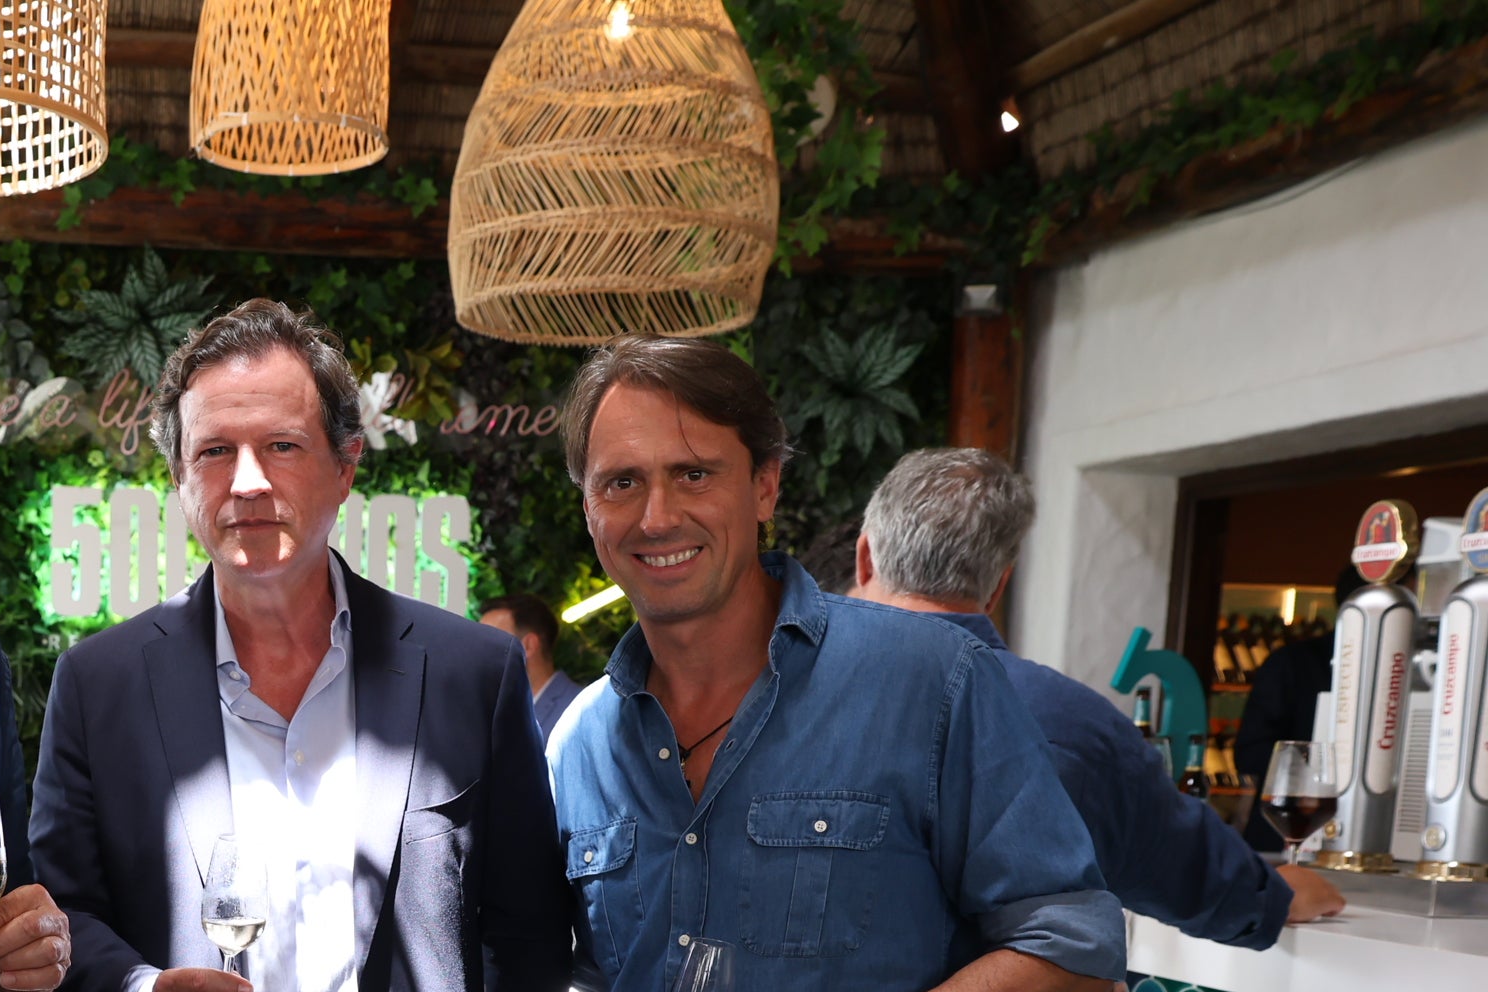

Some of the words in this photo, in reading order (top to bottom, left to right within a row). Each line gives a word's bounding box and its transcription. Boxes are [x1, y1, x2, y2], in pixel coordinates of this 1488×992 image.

[40, 395, 78, 428] a
[98, 368, 155, 456] lif
[1377, 651, 1406, 751] Cruzcampo
